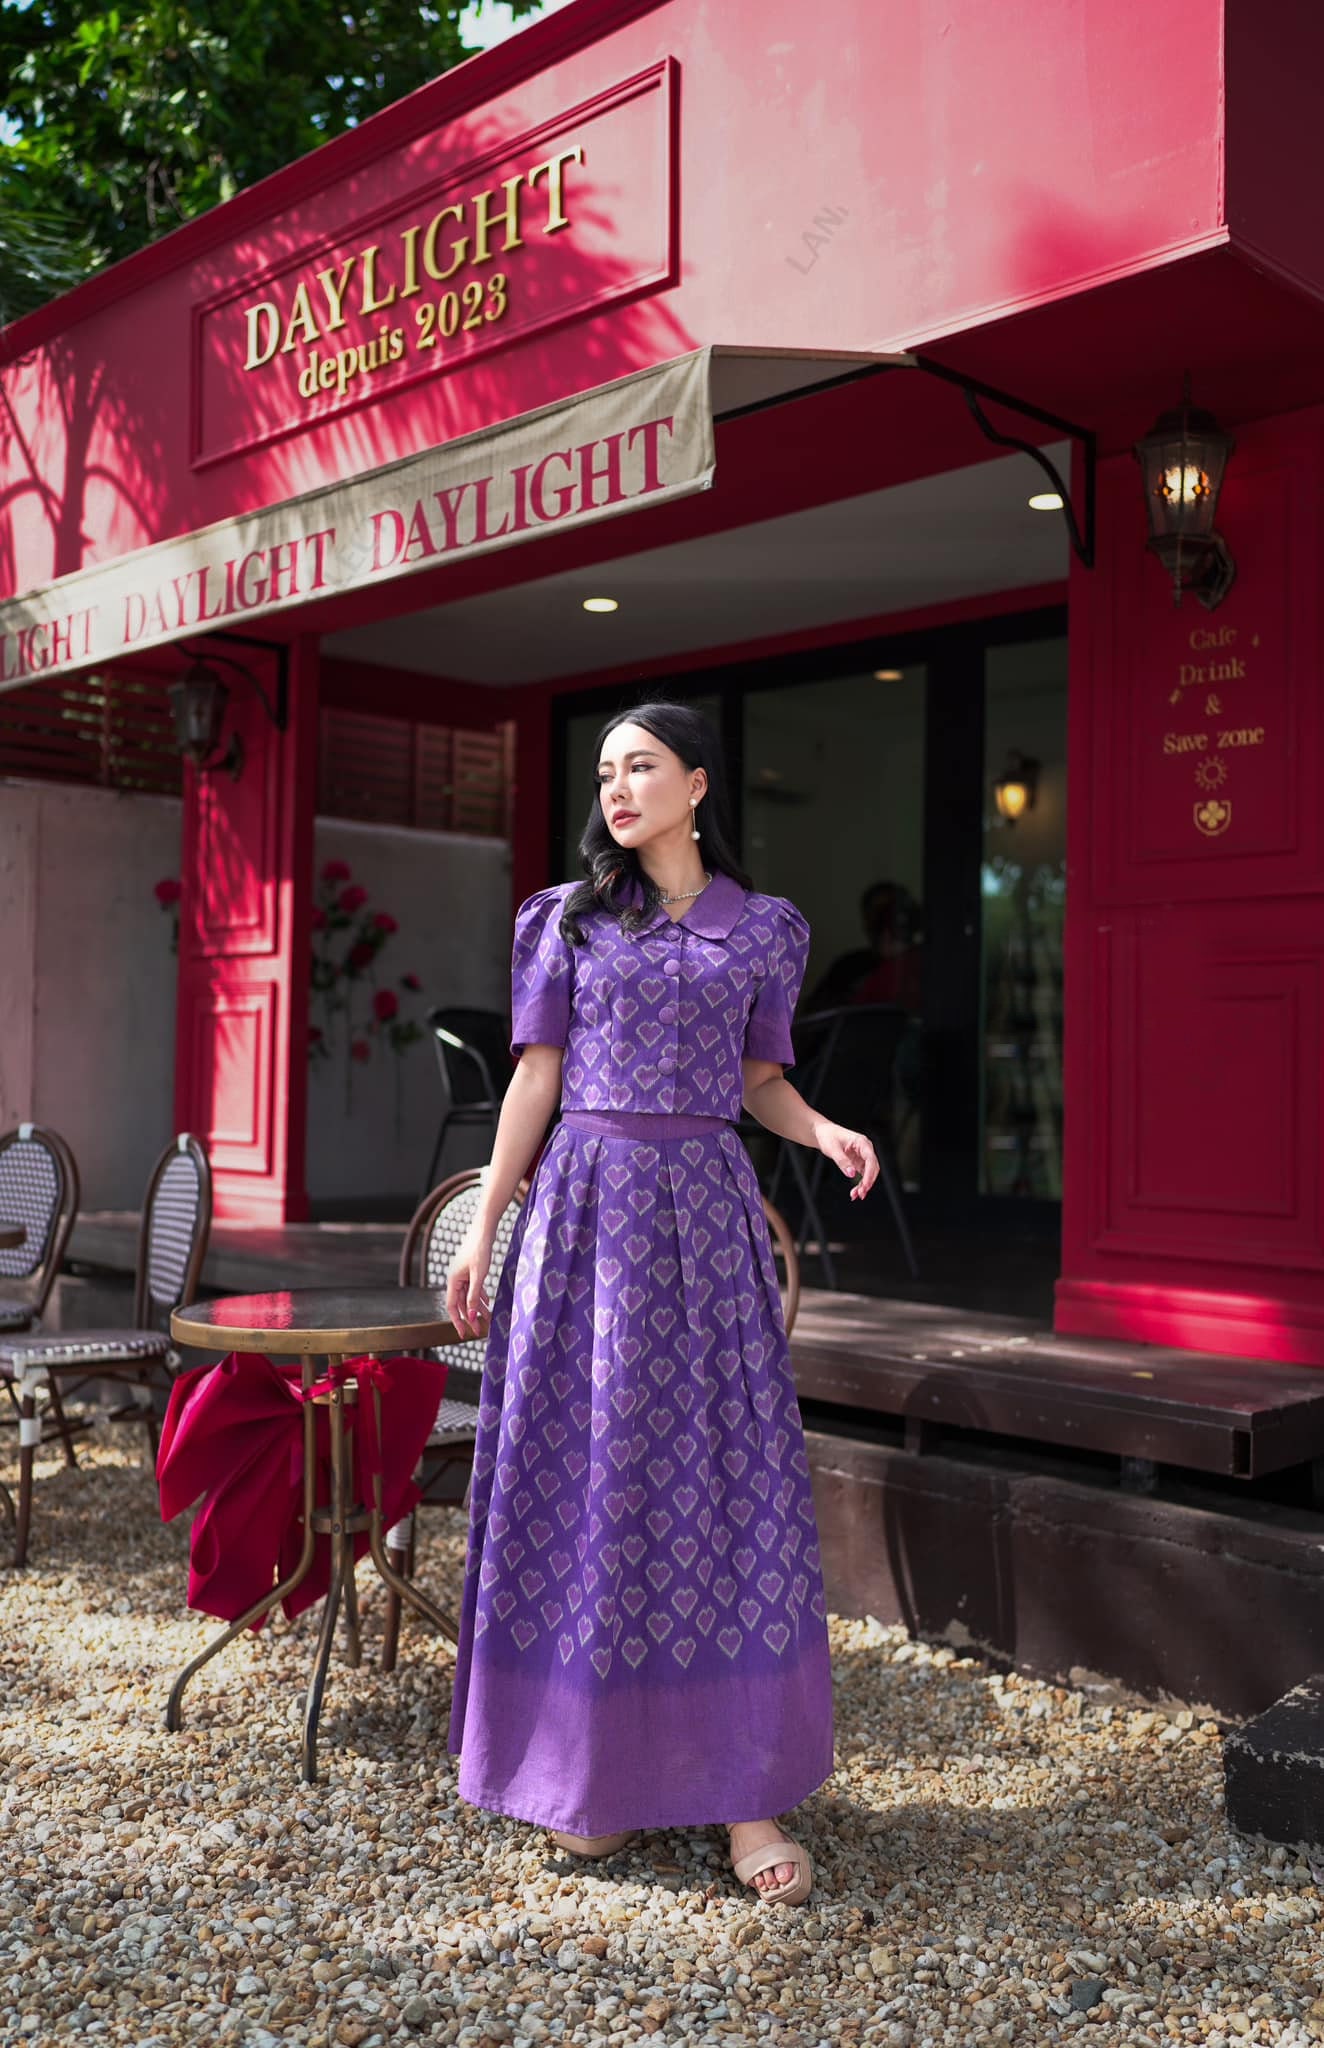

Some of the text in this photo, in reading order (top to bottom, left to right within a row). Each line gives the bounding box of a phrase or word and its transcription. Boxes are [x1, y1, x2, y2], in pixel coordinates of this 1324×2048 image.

[243, 144, 583, 372] DAYLIGHT
[298, 272, 507, 398] depuis 2023
[123, 527, 336, 644] DAYLIGHT
[369, 415, 674, 572] DAYLIGHT
[1191, 626, 1236, 649] Cafe
[1180, 658, 1245, 686] Drink
[1206, 695, 1221, 715] &
[1163, 727, 1264, 754] Save zone
